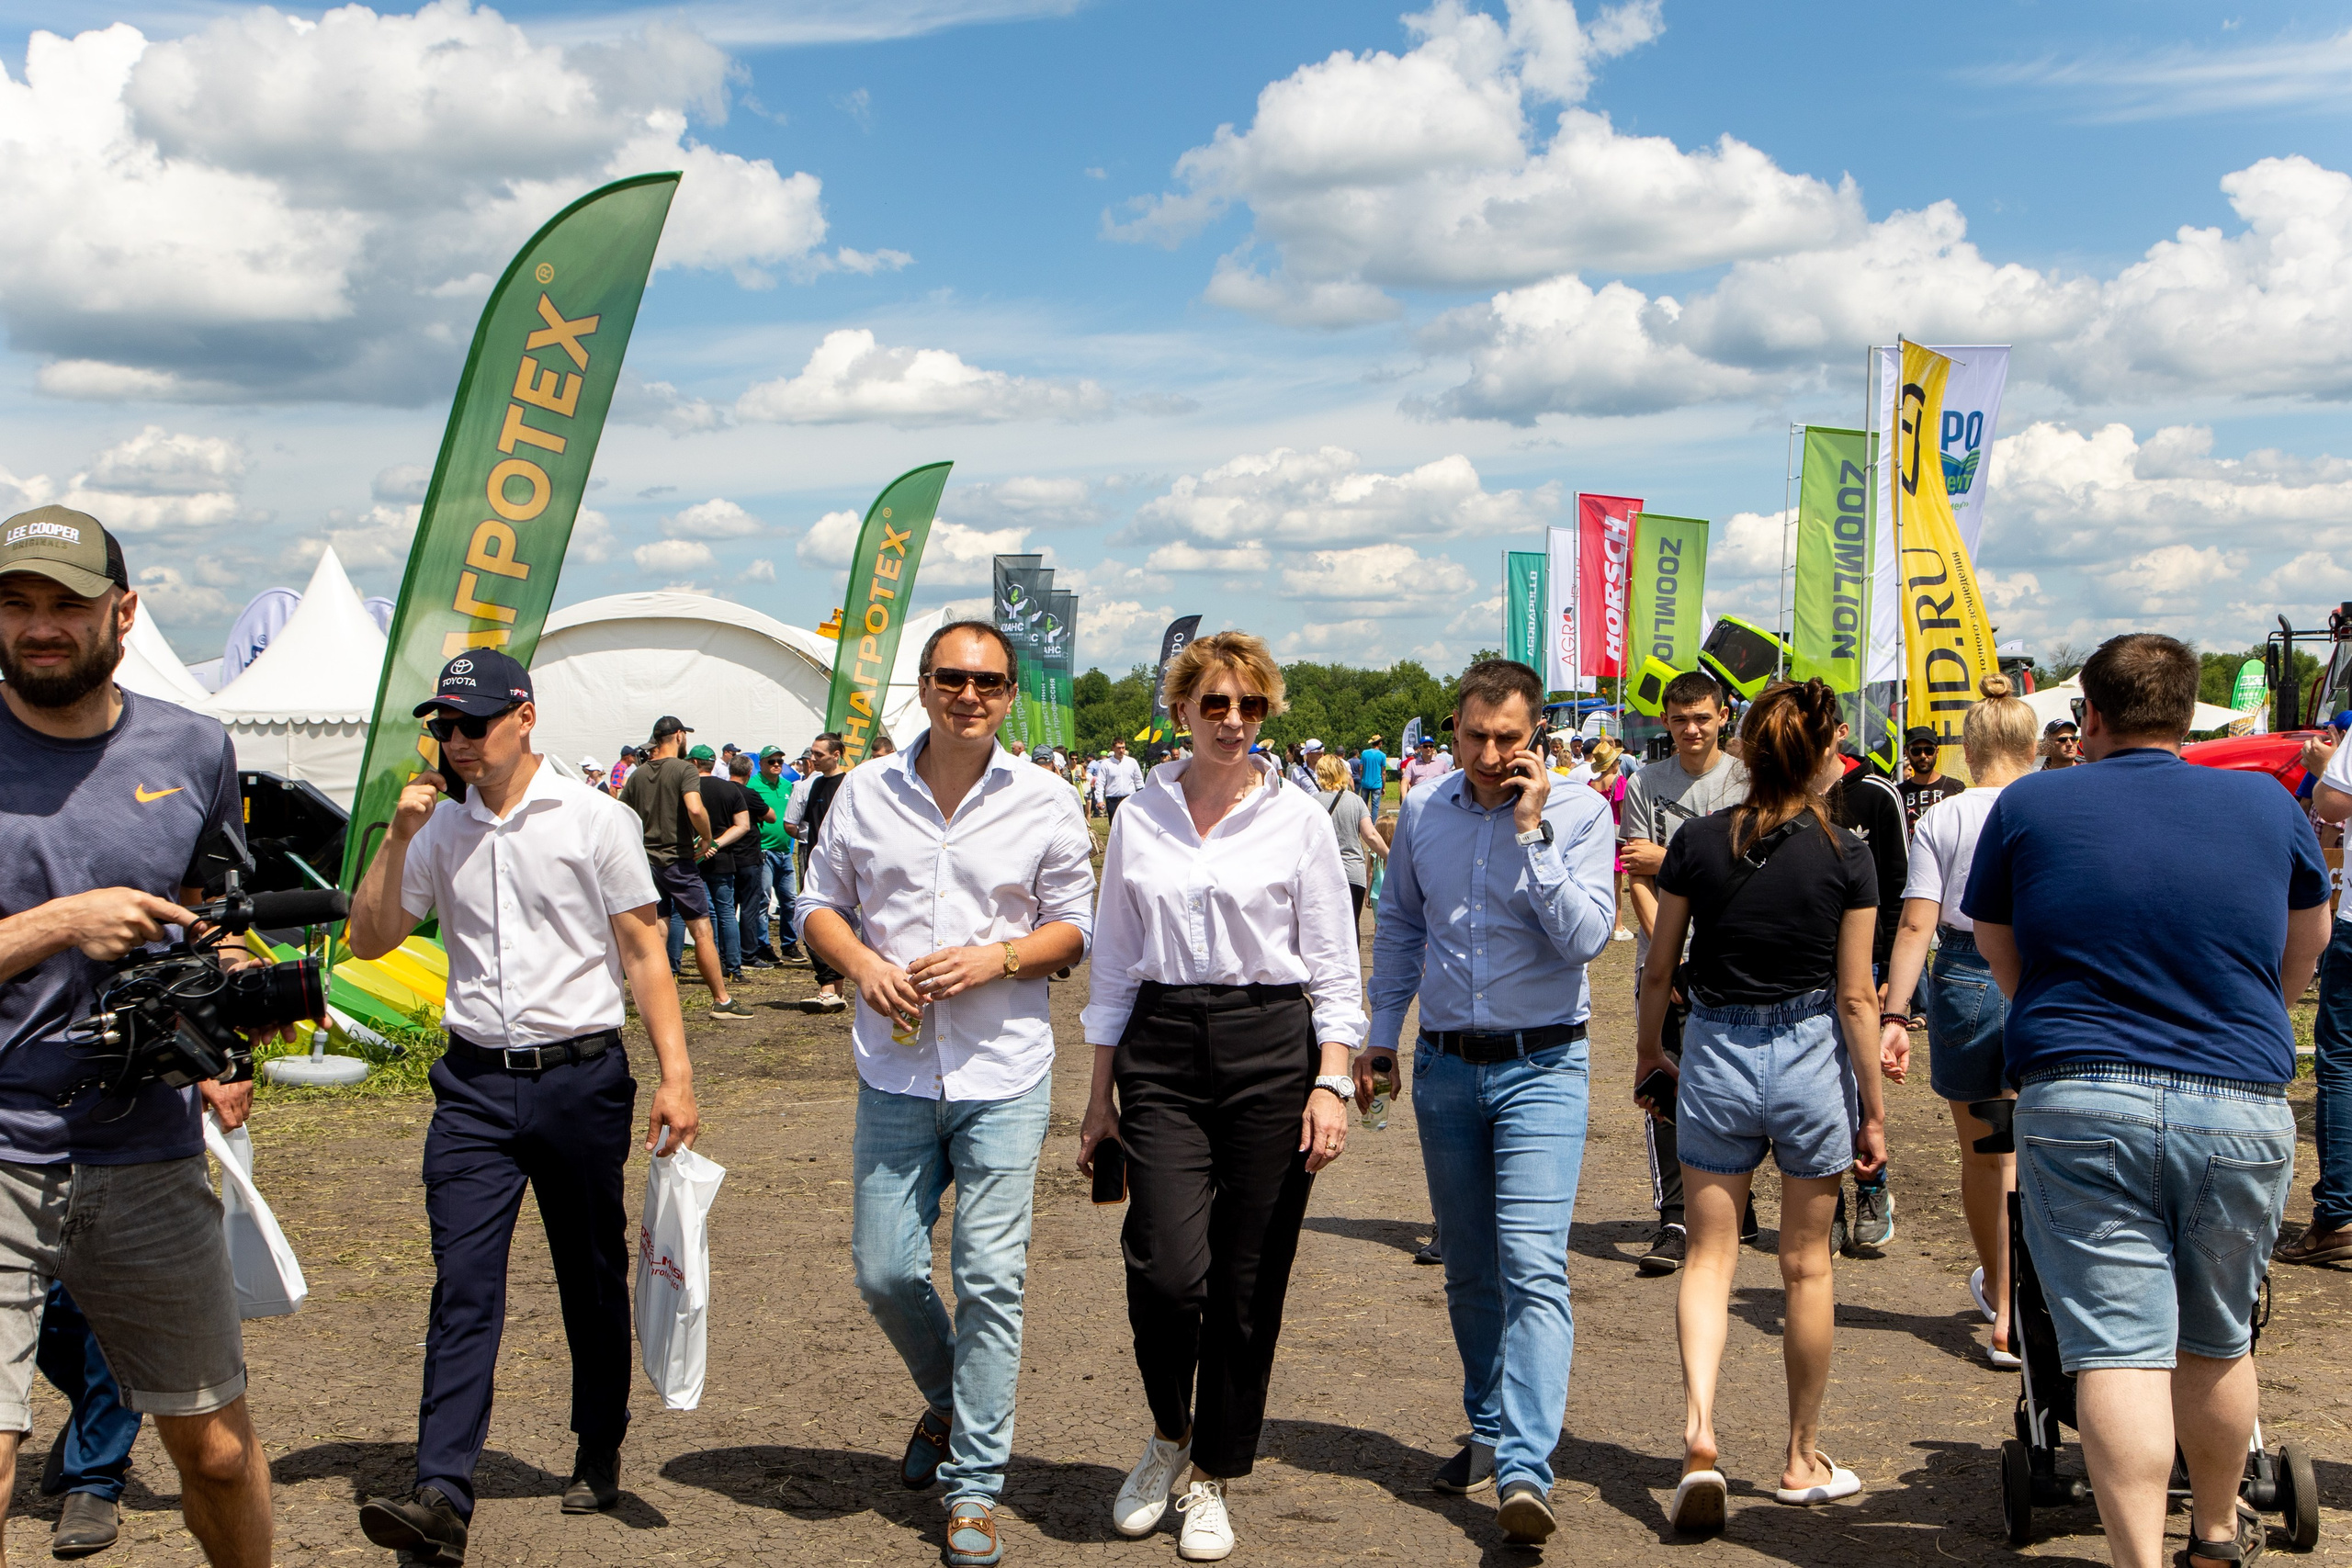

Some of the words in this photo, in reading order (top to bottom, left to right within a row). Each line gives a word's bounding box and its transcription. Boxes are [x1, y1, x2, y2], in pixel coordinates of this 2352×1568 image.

[6, 525, 28, 542] LEE
[28, 522, 80, 541] COOPER
[12, 537, 68, 551] ORIGINALS
[1831, 459, 1871, 660] ZOOMLION
[1526, 570, 1538, 658] AGROAPOLLO
[1604, 514, 1627, 662] HORSCH
[1652, 536, 1682, 661] ZOOMLIO
[442, 676, 477, 687] TOYOTA
